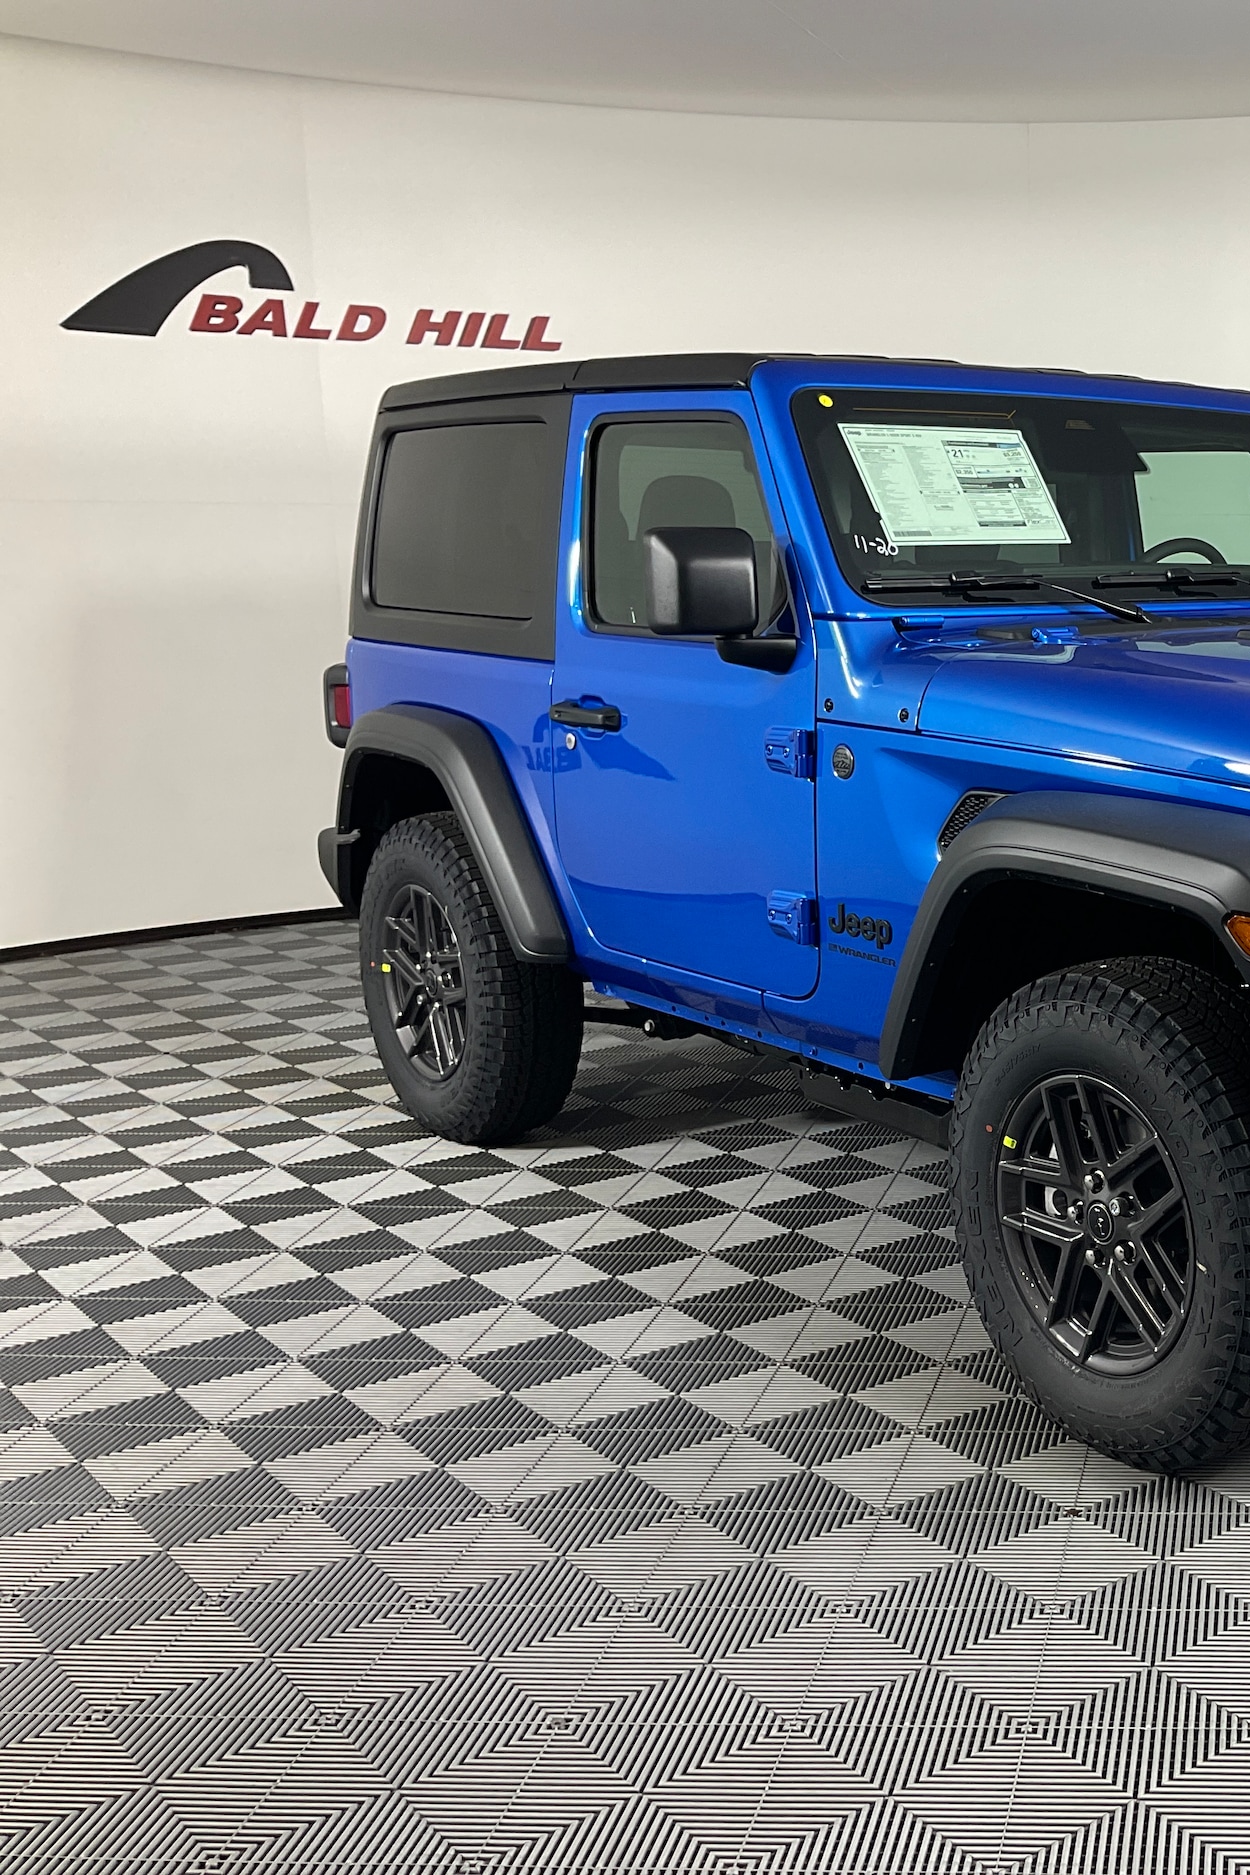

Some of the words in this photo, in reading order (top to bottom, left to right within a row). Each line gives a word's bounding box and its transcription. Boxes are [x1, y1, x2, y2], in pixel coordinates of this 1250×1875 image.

[188, 293, 387, 342] BALD
[405, 308, 563, 352] HILL
[951, 449, 964, 459] 21
[828, 903, 894, 949] Jeep
[838, 945, 897, 967] WRANGLER
